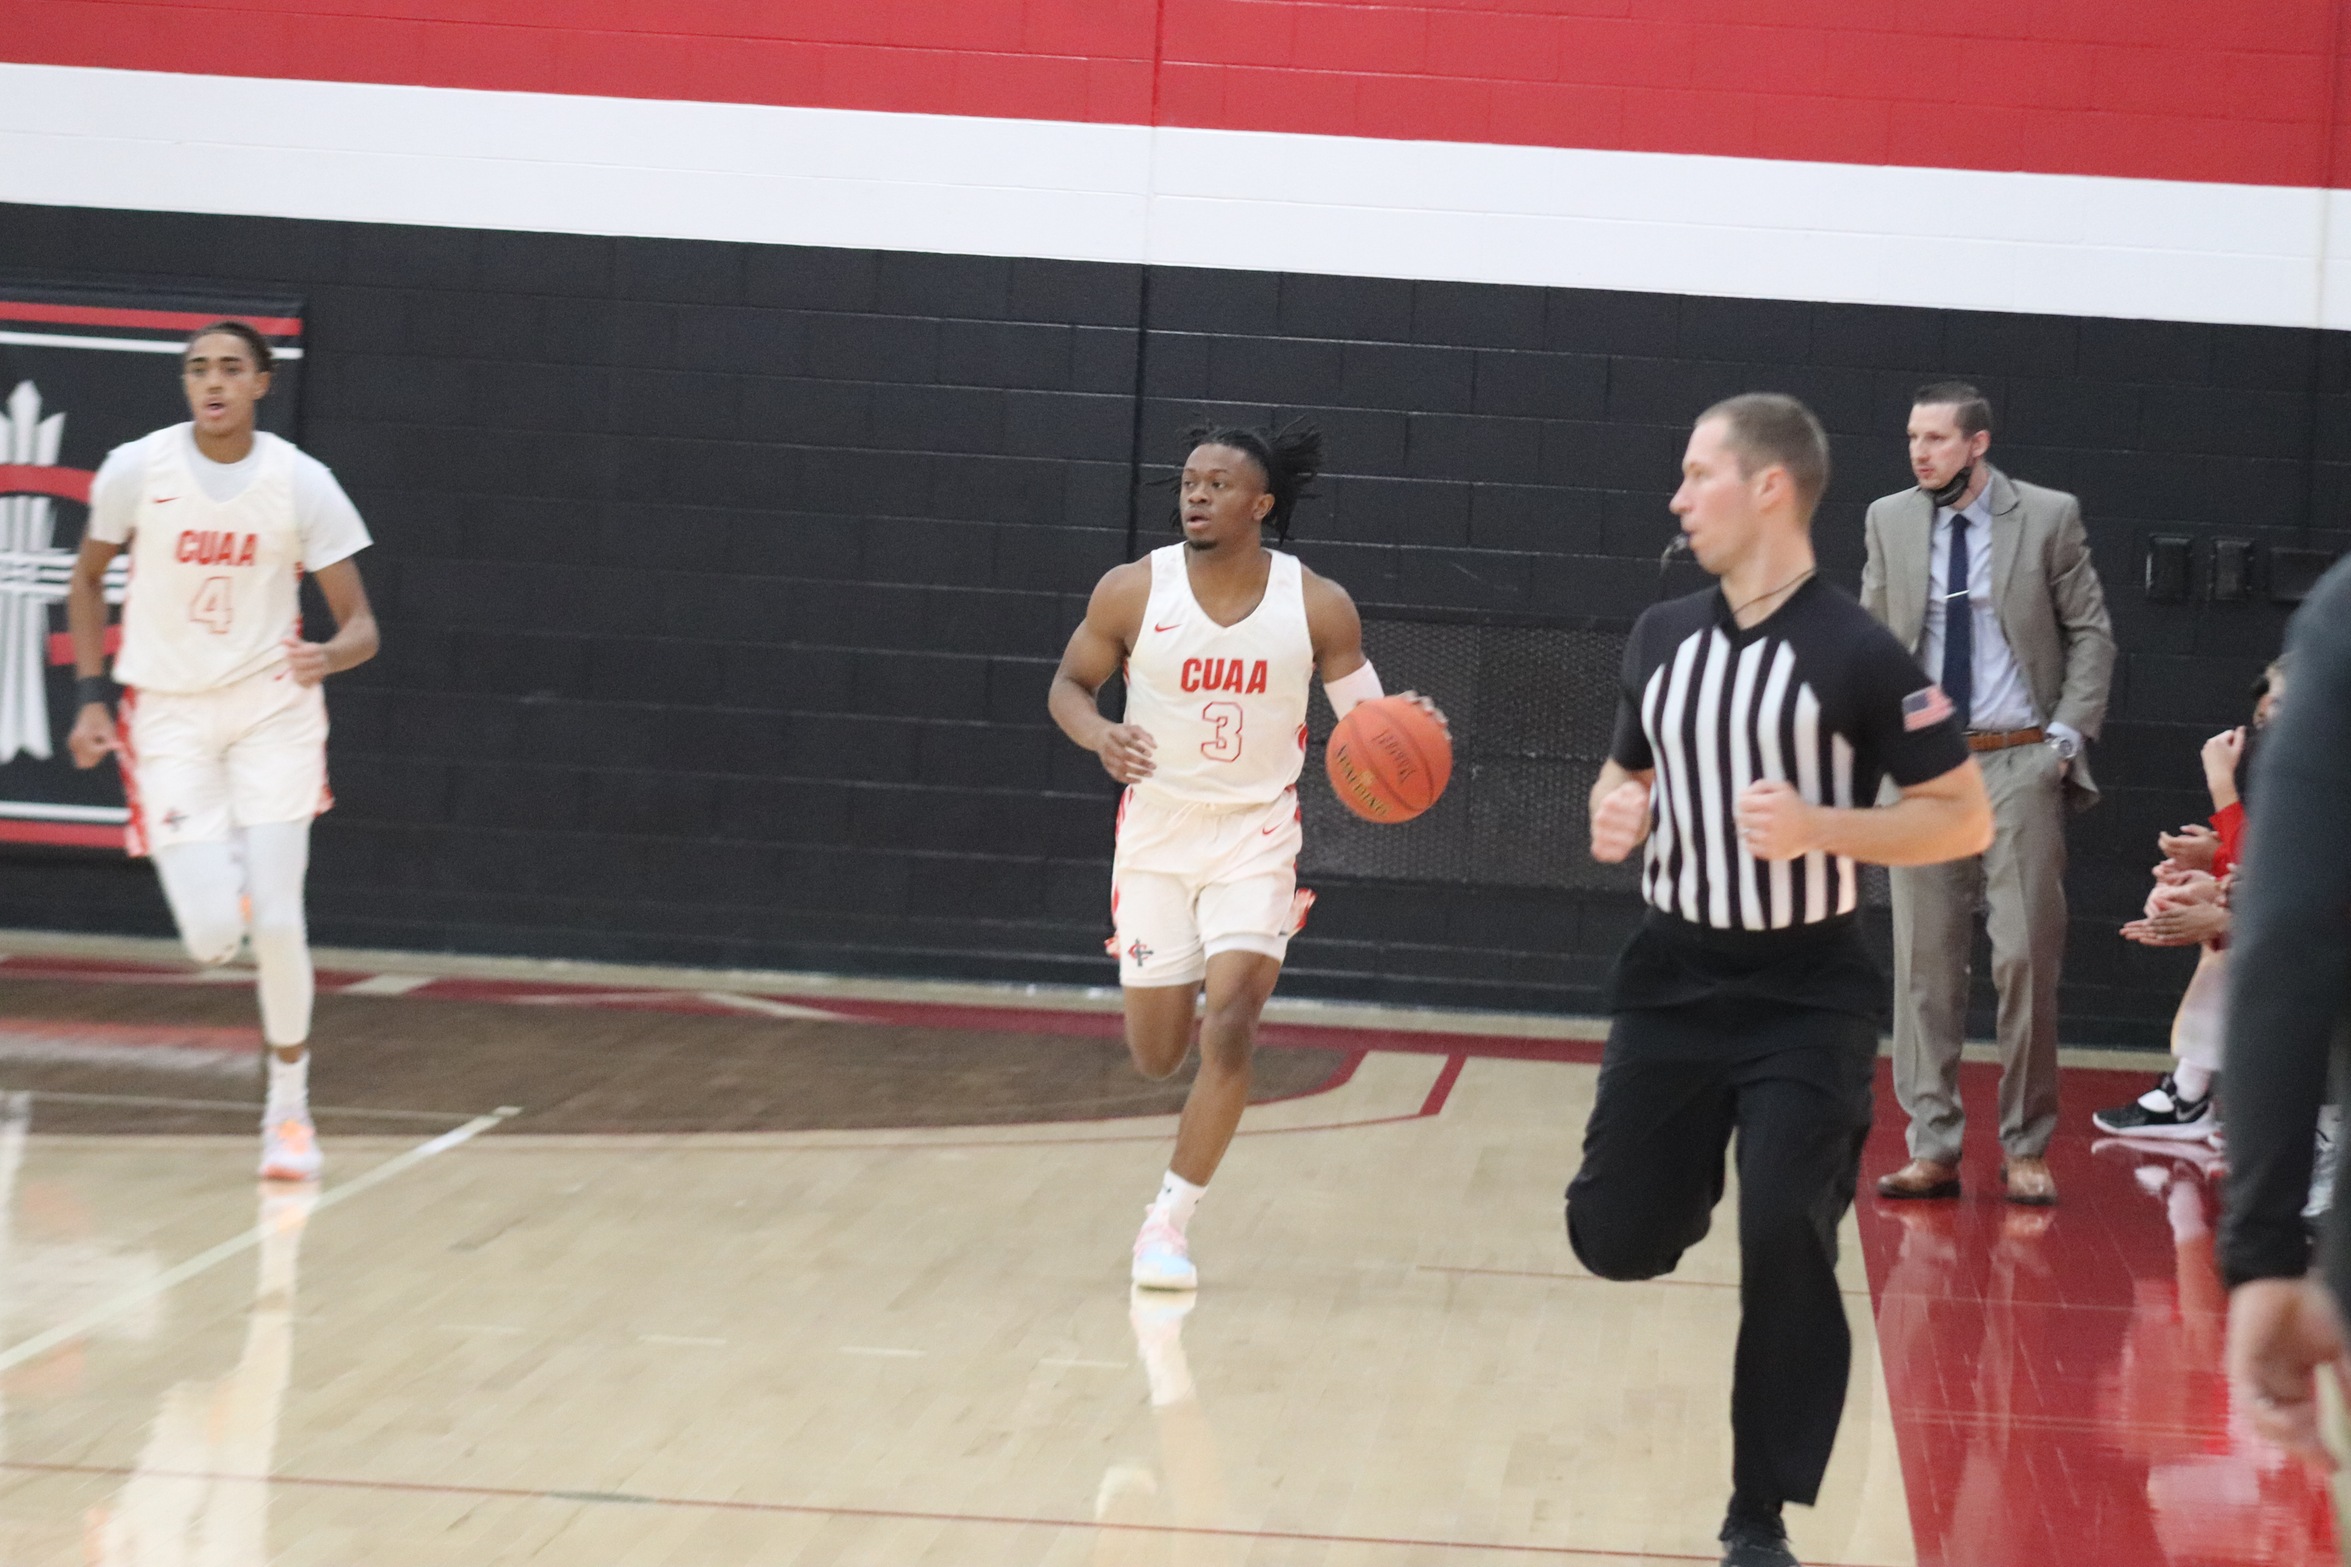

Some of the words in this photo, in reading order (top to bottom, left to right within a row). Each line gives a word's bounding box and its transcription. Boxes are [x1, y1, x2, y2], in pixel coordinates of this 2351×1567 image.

[175, 529, 259, 567] CUAA
[188, 576, 233, 634] 4
[1180, 657, 1268, 694] CUAA
[1200, 701, 1243, 763] 3
